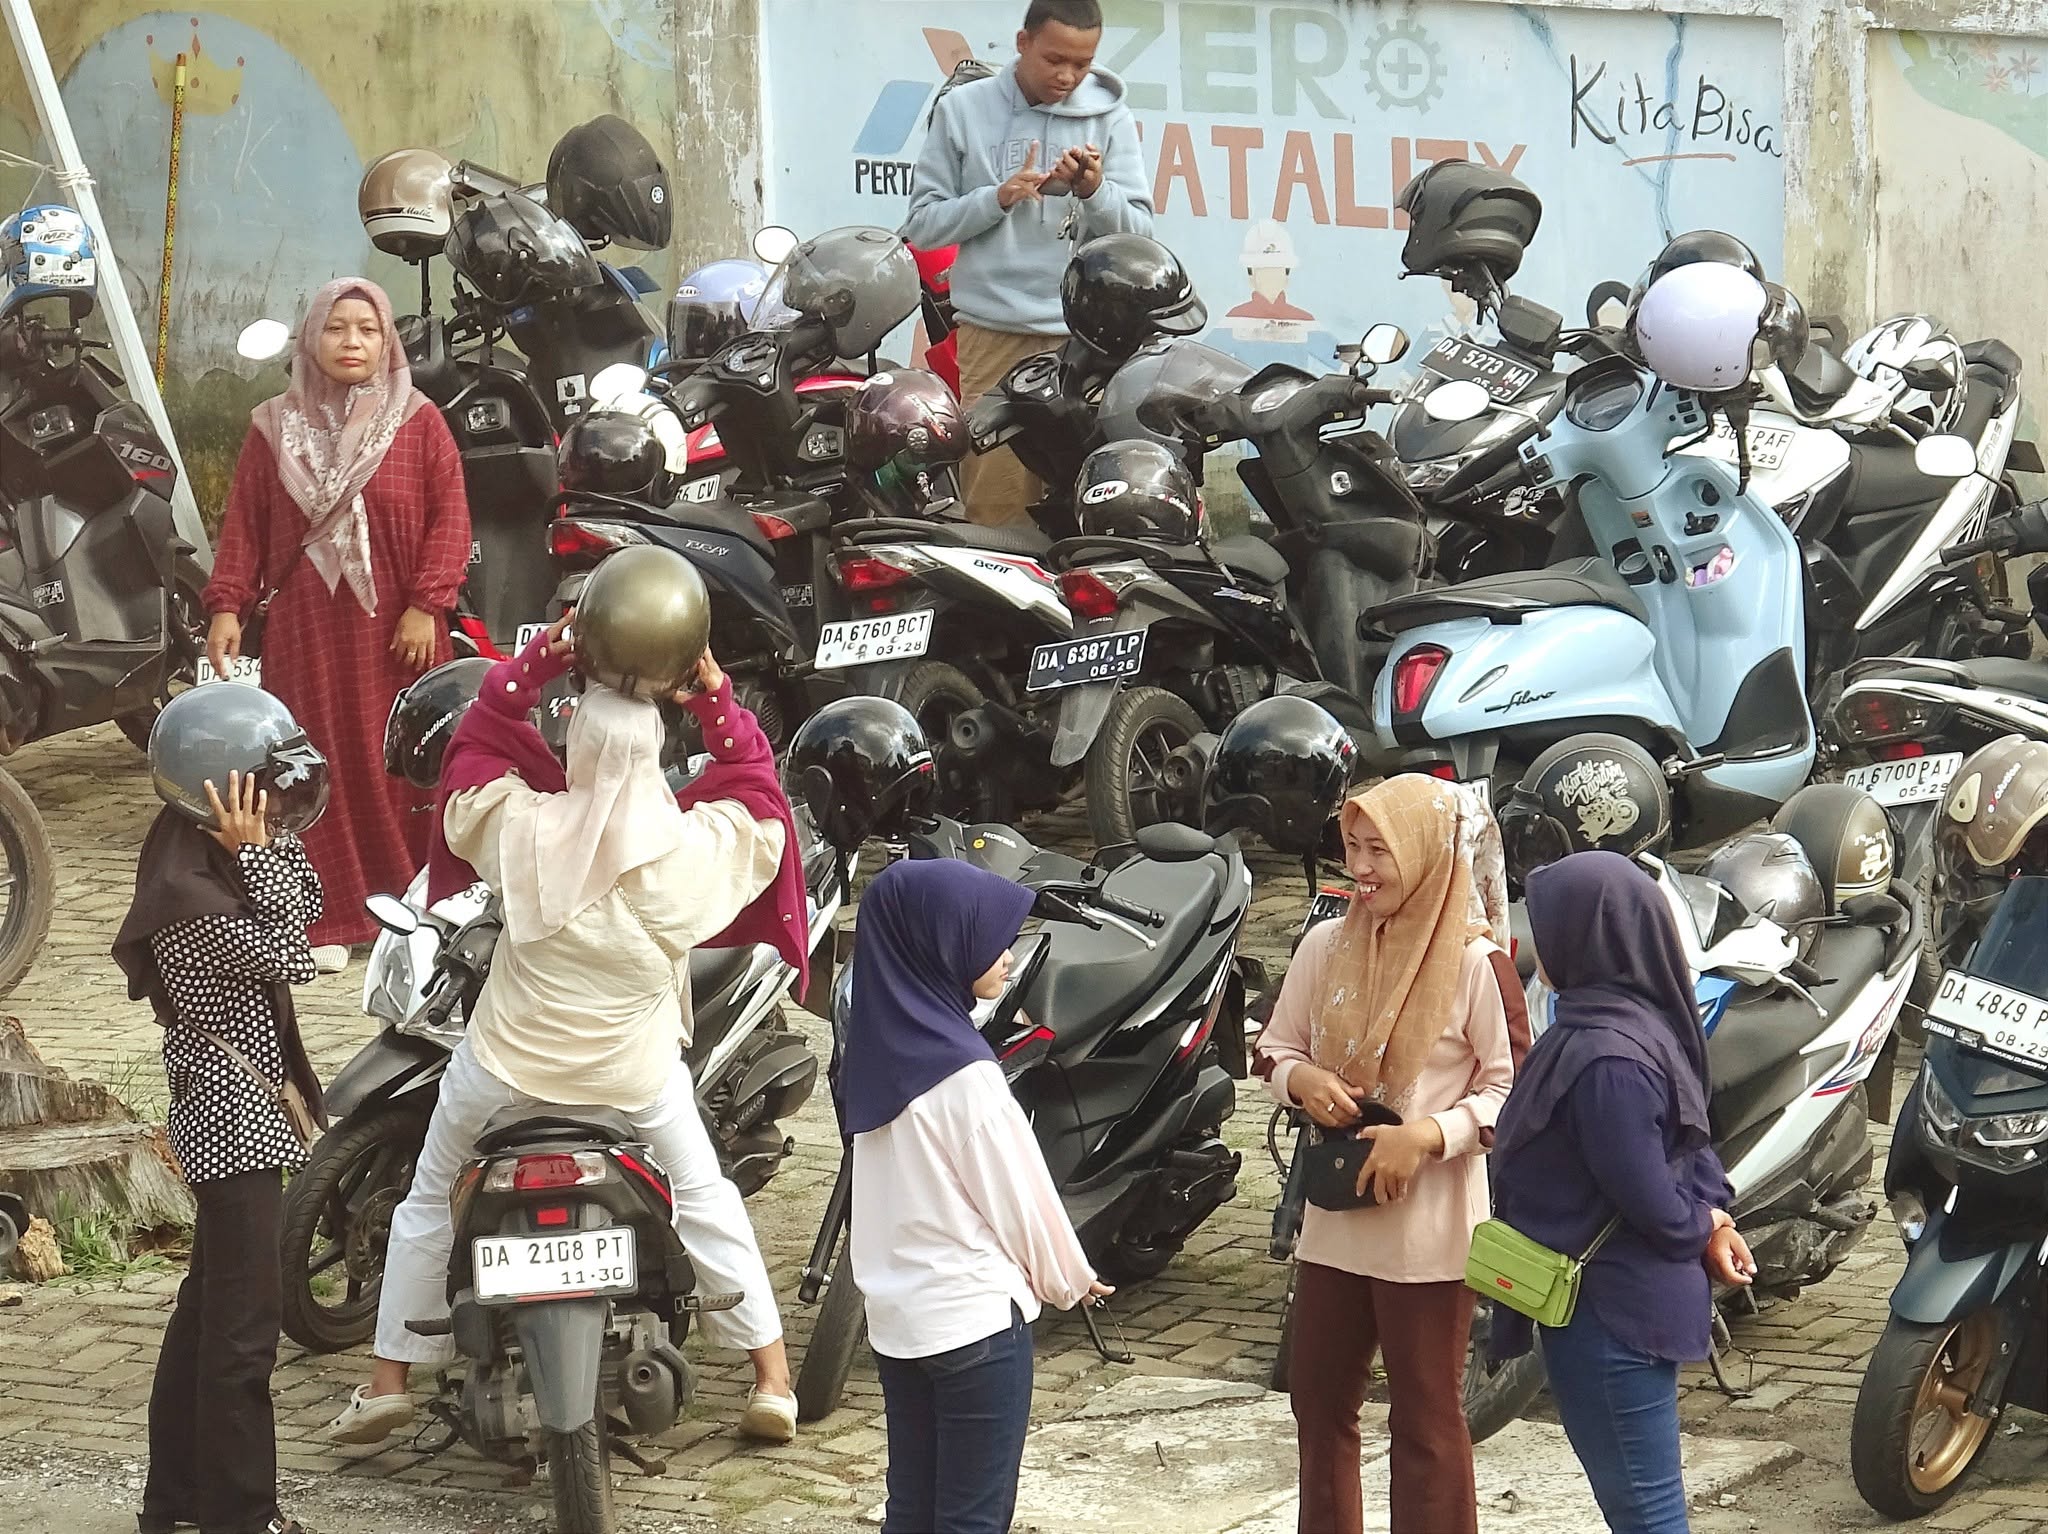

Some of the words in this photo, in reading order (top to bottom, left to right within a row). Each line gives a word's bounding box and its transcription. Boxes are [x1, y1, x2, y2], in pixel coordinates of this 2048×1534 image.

[1570, 54, 1685, 149] Kita
[1691, 74, 1783, 158] Bisa
[1136, 120, 1528, 231] ATALI
[1436, 339, 1462, 359] DA
[1462, 349, 1504, 375] 5273
[1502, 366, 1530, 387] MA
[1753, 430, 1789, 448] PAF
[119, 440, 172, 471] 160
[697, 480, 715, 500] CV
[1091, 485, 1118, 499] GM
[822, 627, 843, 646] DA
[849, 620, 892, 642] 6760
[897, 615, 928, 636] BCT
[1037, 650, 1058, 671] DA
[1067, 640, 1110, 665] 6387
[1116, 635, 1140, 656] LP
[1871, 762, 1917, 785] 6700
[1941, 978, 1967, 1005] DA
[1976, 990, 2028, 1023] 4849
[1929, 1021, 1956, 1039] YAMAHA
[481, 1245, 509, 1268] DA
[528, 1240, 584, 1264] 2108
[596, 1236, 622, 1259] PT
